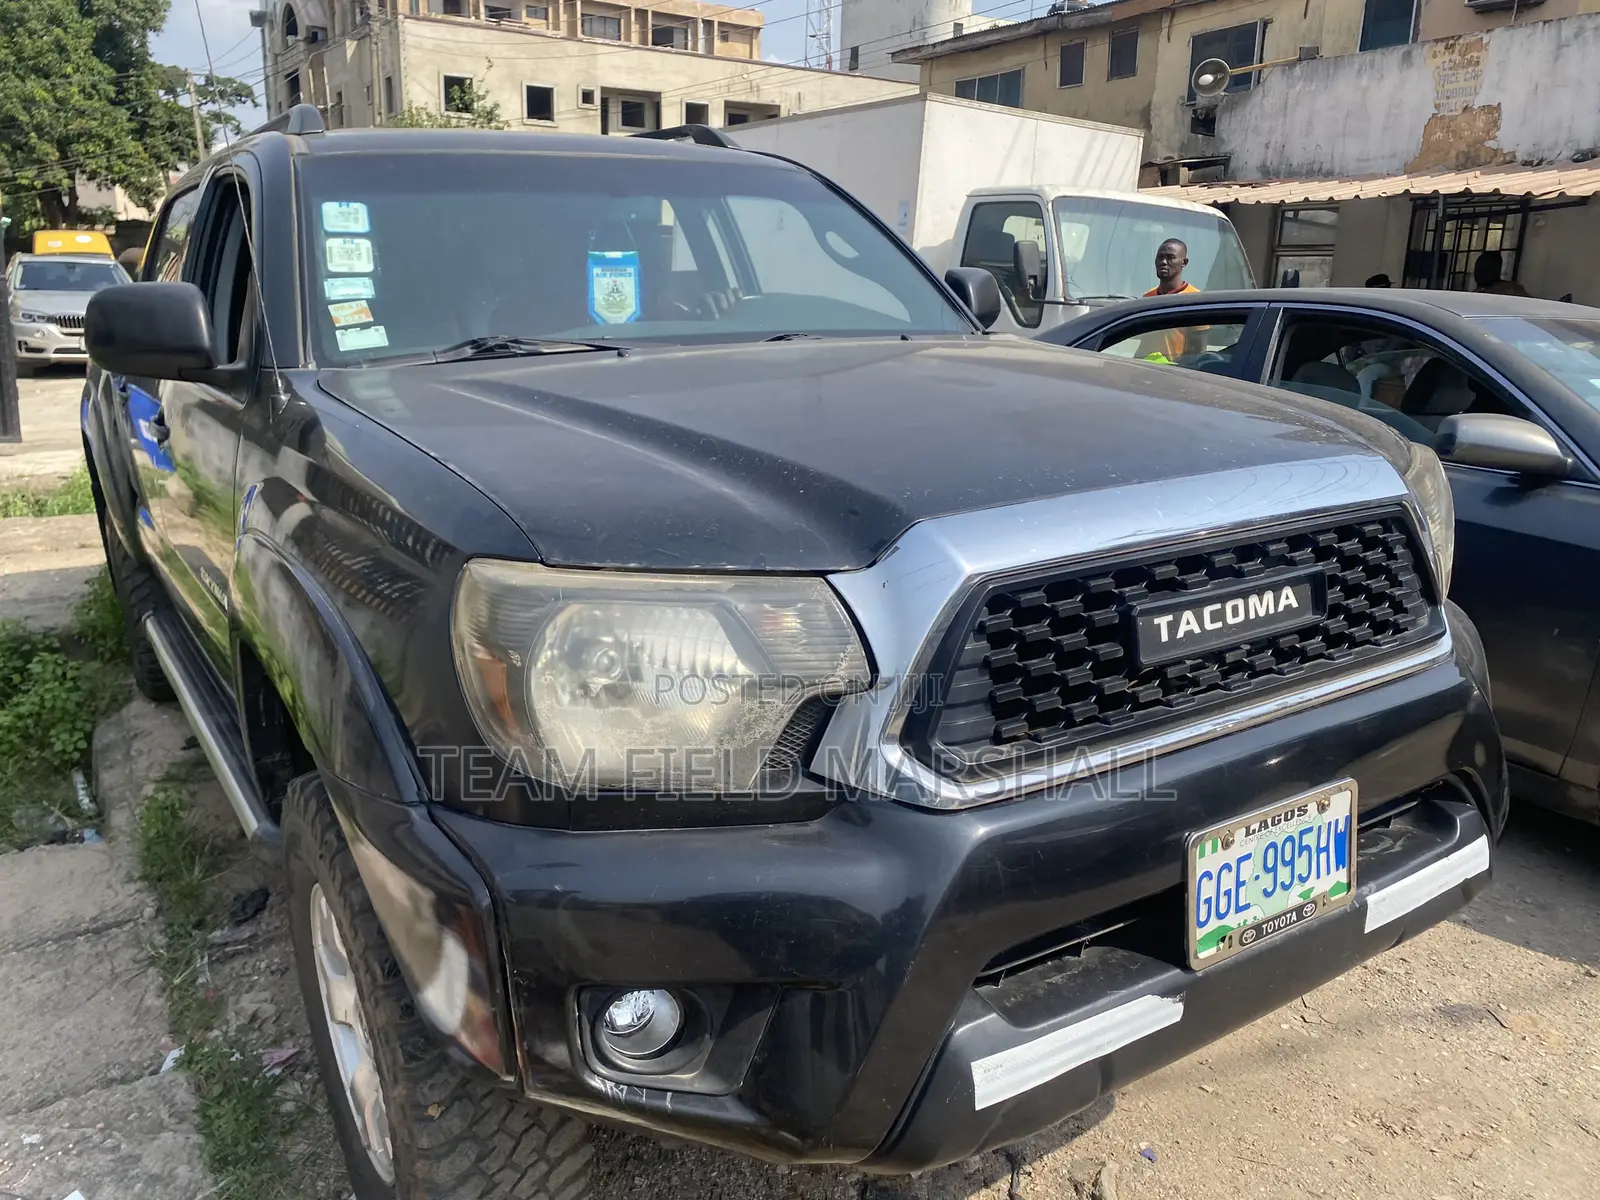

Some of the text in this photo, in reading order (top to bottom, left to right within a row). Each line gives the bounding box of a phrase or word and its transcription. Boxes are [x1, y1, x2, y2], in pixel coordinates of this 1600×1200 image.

[1153, 585, 1299, 642] TACOMA
[1239, 831, 1264, 847] CENTRE
[1274, 814, 1312, 834] EXCELLENCE
[1244, 803, 1309, 838] LAGOS
[1261, 911, 1298, 936] TOYOTA
